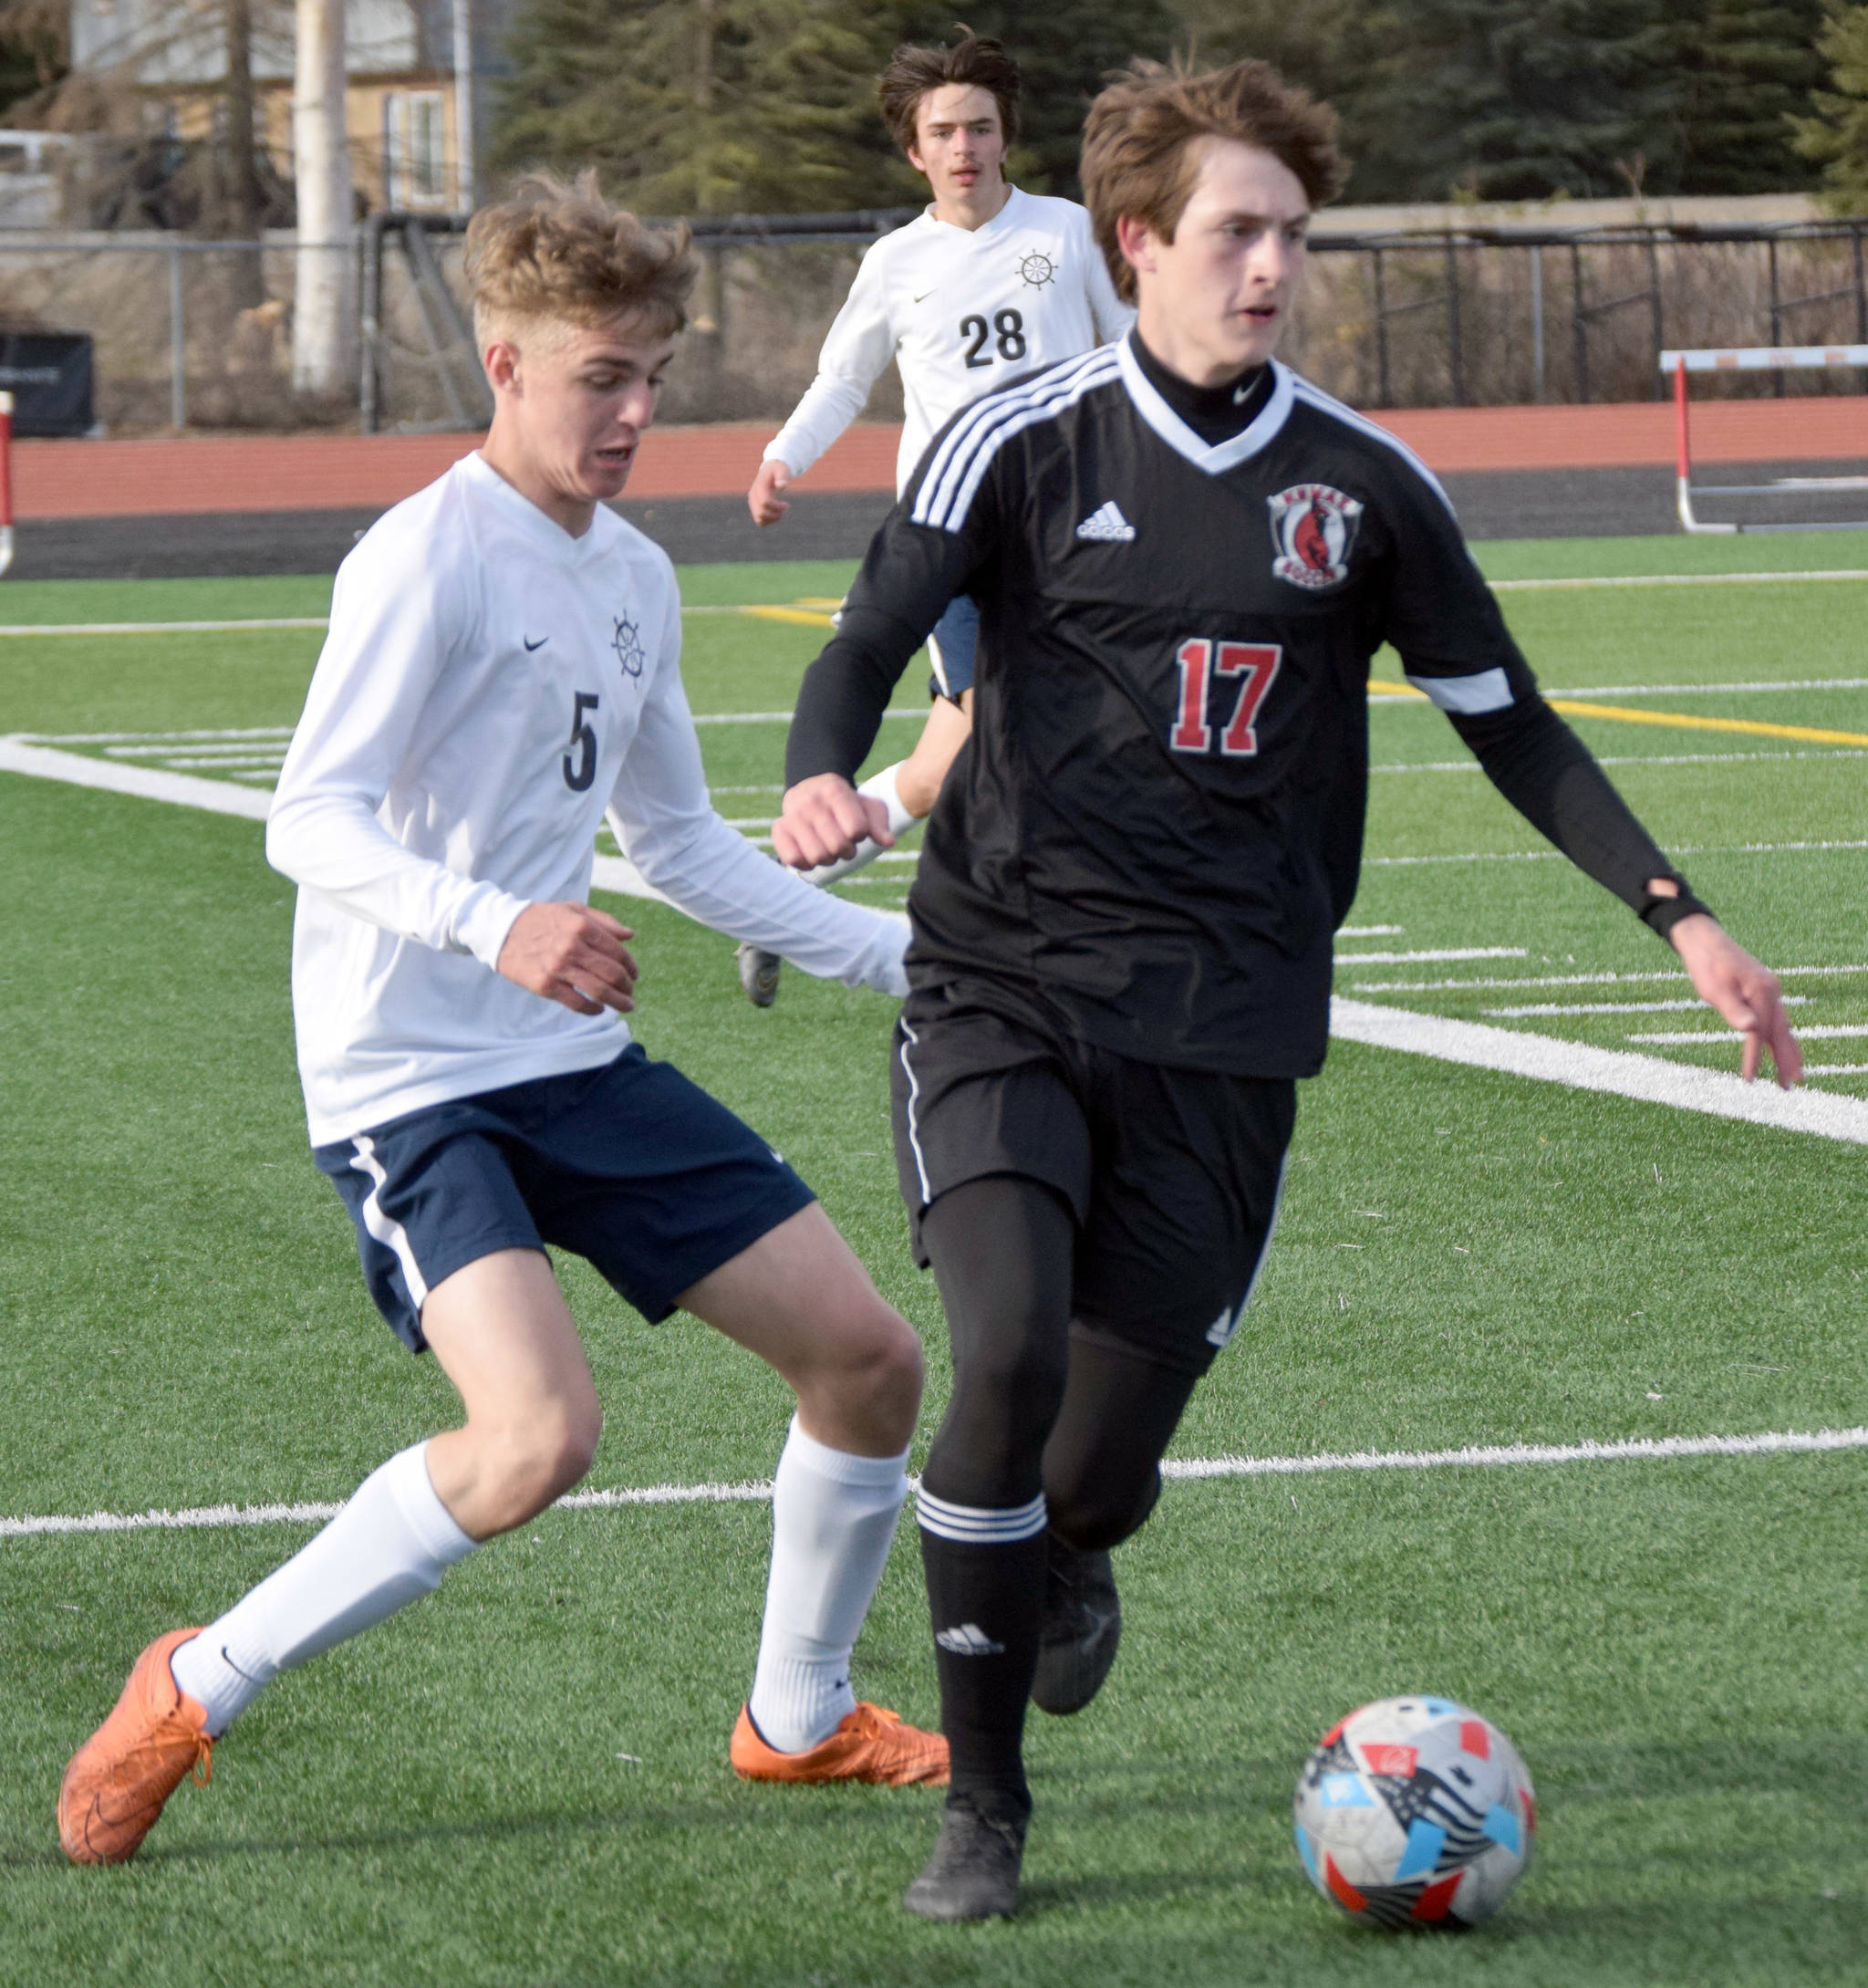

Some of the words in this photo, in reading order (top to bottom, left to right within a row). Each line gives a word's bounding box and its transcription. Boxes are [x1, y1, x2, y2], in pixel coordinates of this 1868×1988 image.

[960, 307, 1026, 369] 28
[563, 691, 599, 792] 5
[1169, 638, 1282, 755] 17
